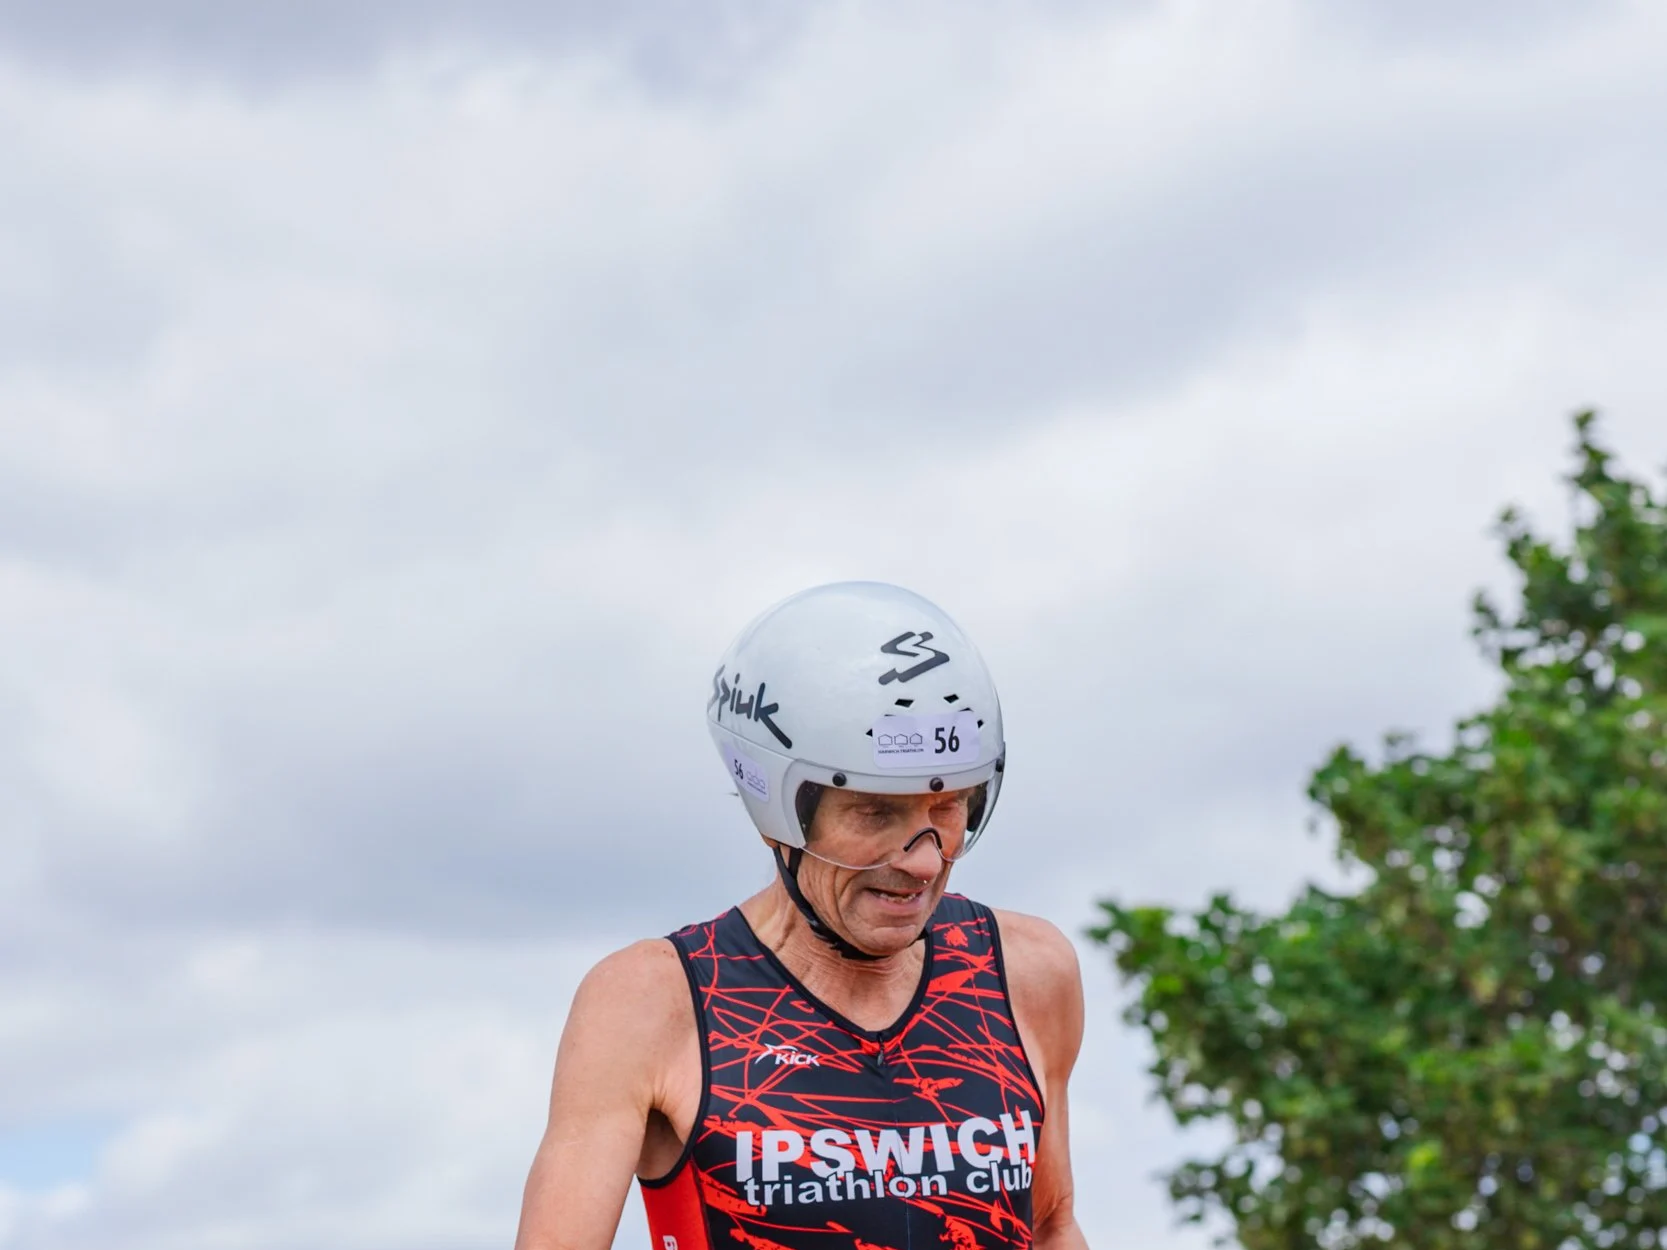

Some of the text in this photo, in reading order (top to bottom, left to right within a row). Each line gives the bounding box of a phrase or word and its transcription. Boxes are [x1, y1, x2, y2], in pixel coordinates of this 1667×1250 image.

[934, 726, 960, 754] 56
[735, 1110, 1036, 1182] IPSWICH
[744, 1160, 1033, 1206] triathlon club
